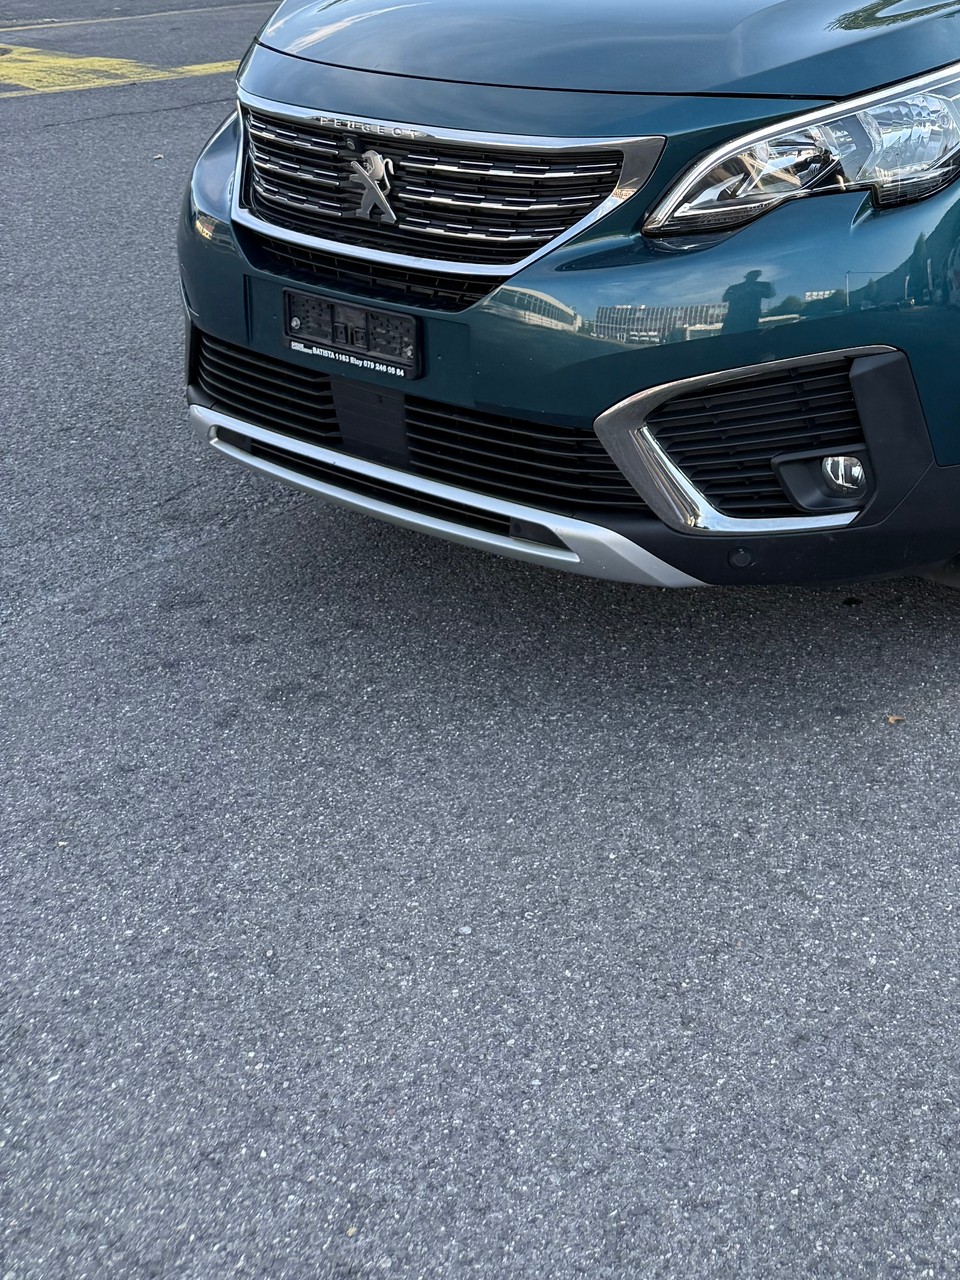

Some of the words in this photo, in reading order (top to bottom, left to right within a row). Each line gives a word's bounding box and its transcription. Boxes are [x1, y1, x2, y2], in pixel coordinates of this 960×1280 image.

[320, 116, 417, 139] PEUGEOT
[312, 347, 335, 359] BATISTA
[363, 359, 374, 369] 079
